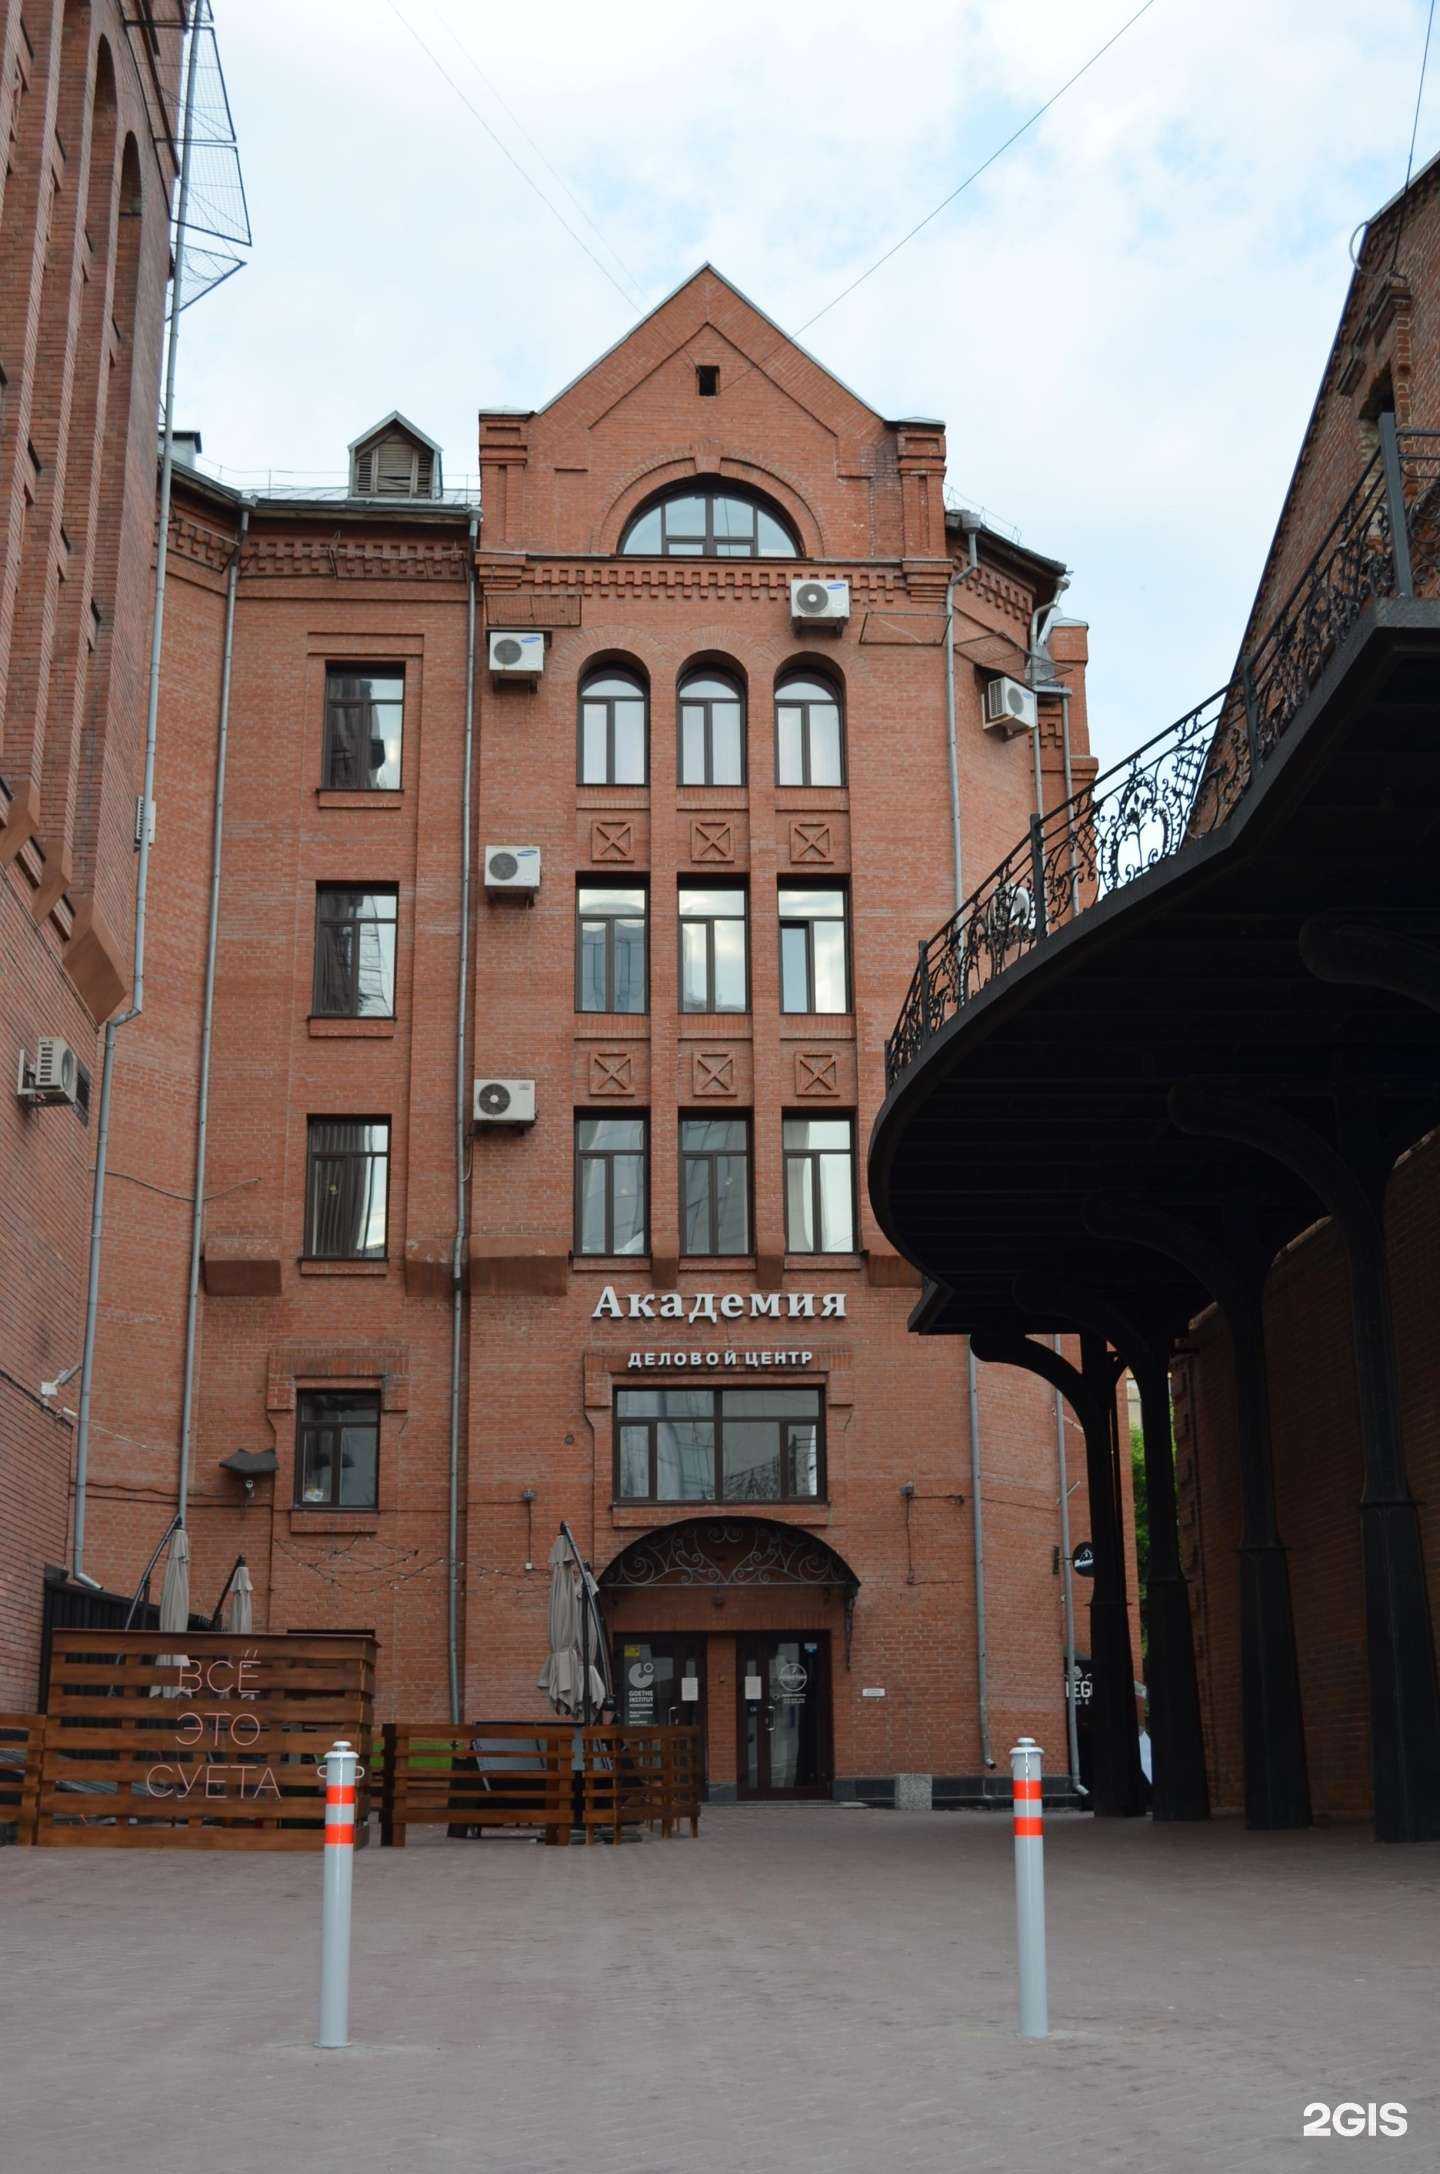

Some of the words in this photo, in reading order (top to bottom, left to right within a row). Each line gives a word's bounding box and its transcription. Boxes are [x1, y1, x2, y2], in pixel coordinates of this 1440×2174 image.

[592, 1286, 848, 1323] Академия
[628, 1350, 737, 1368] ДЕЛОВОЙ
[745, 1351, 813, 1367] ЦЕНТР
[177, 1649, 261, 1694] ВСЁ
[175, 1712, 261, 1746] ЭТО
[146, 1764, 281, 1800] СУЕТА
